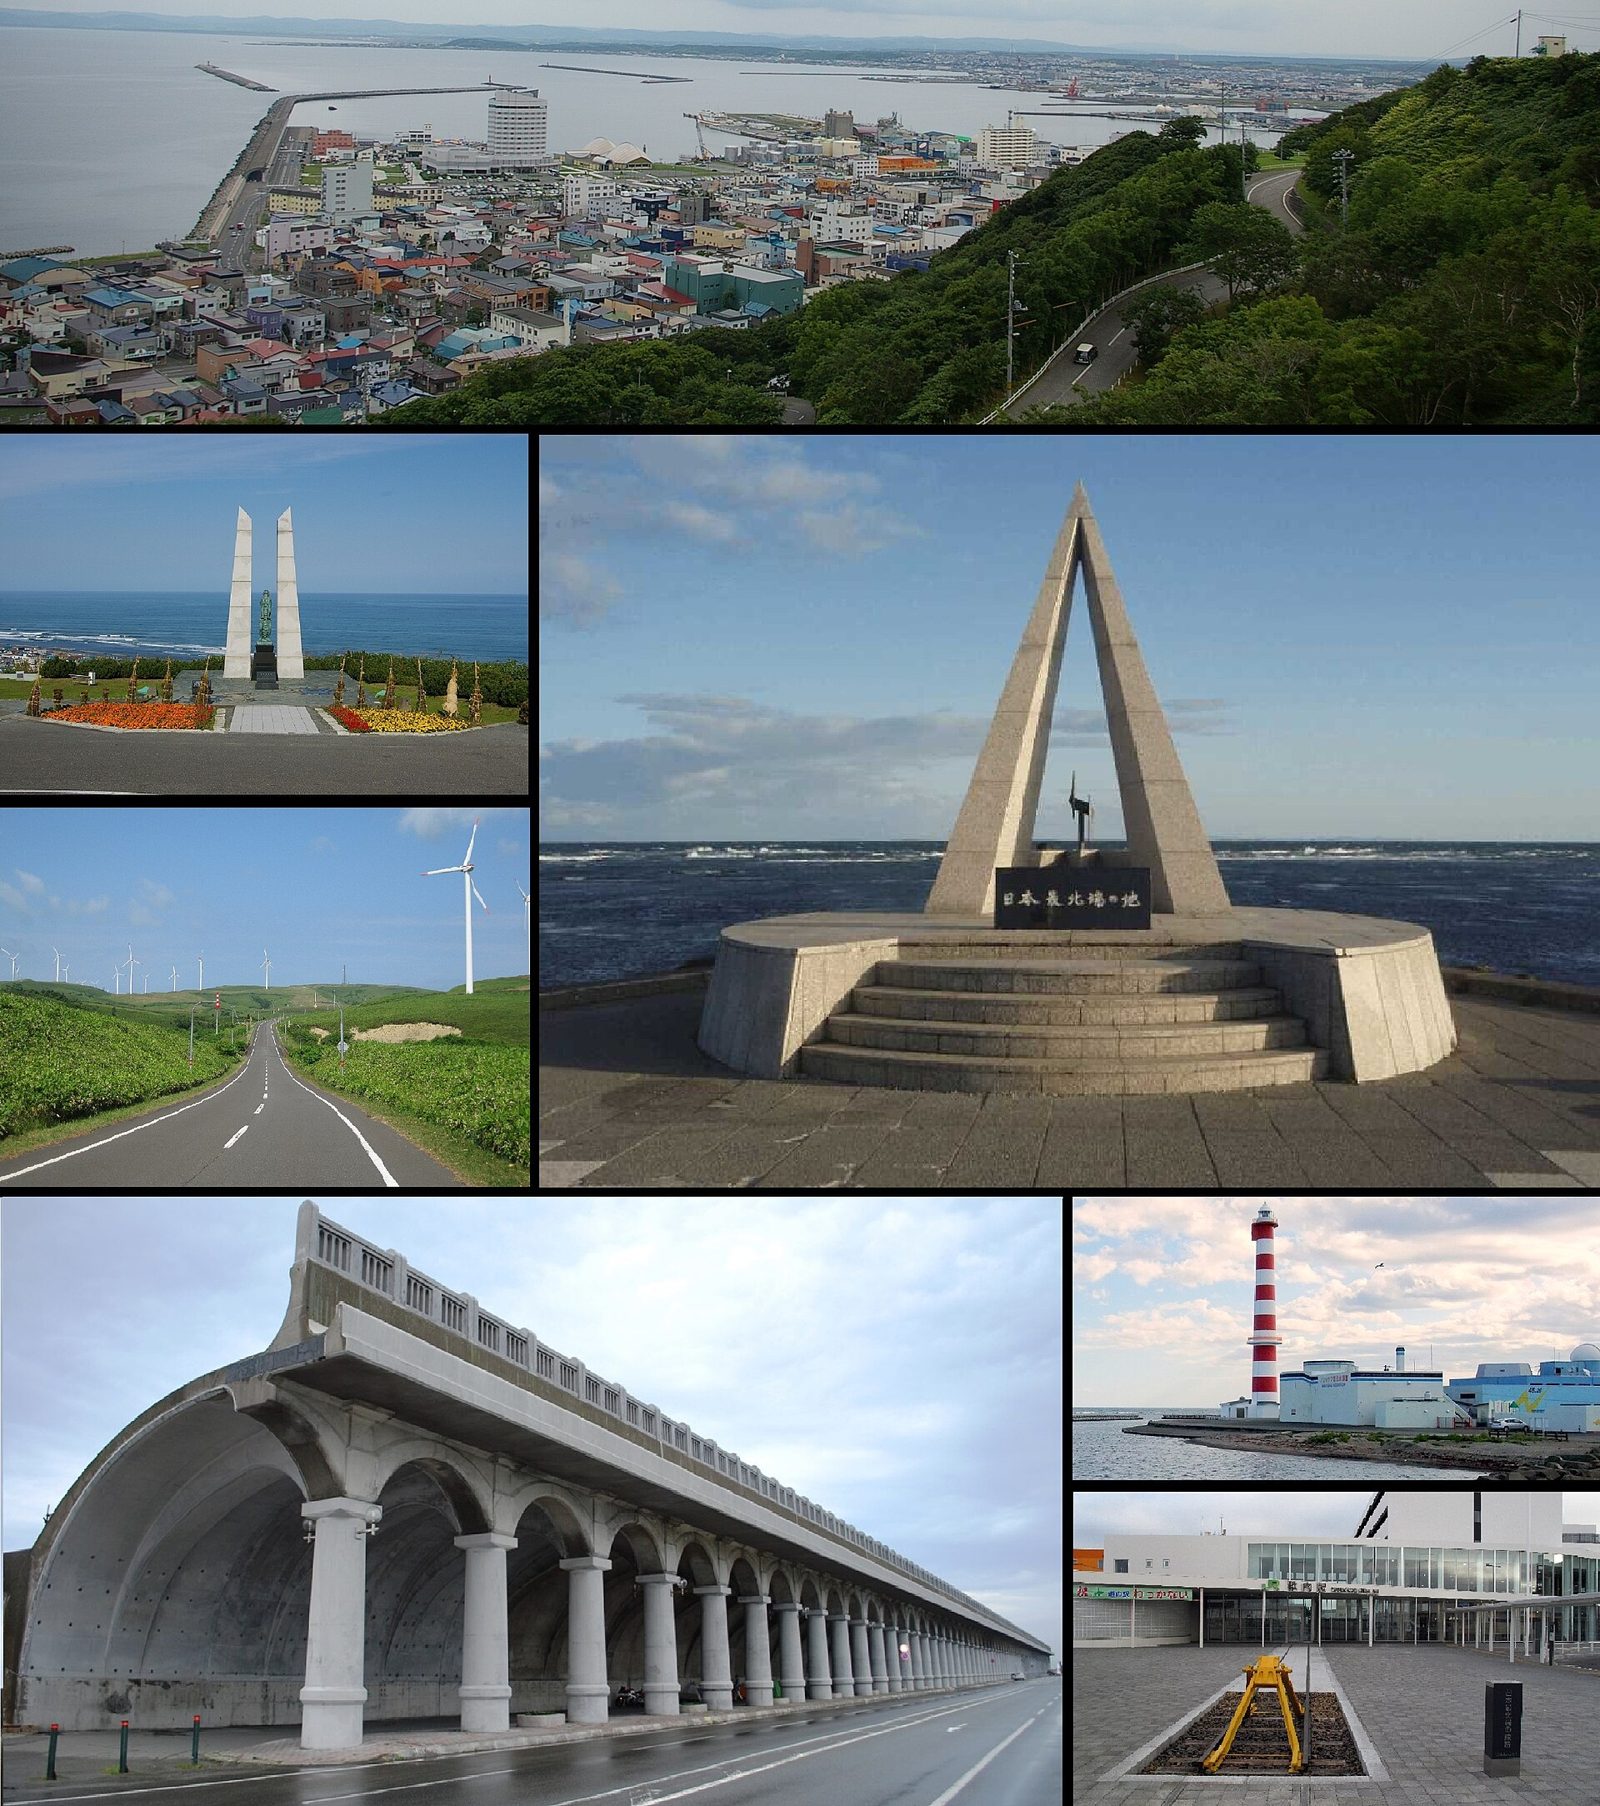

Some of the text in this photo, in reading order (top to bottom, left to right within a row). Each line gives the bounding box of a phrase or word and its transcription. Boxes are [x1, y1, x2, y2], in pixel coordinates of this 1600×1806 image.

[1003, 889, 1141, 908] 日本最北端の地
